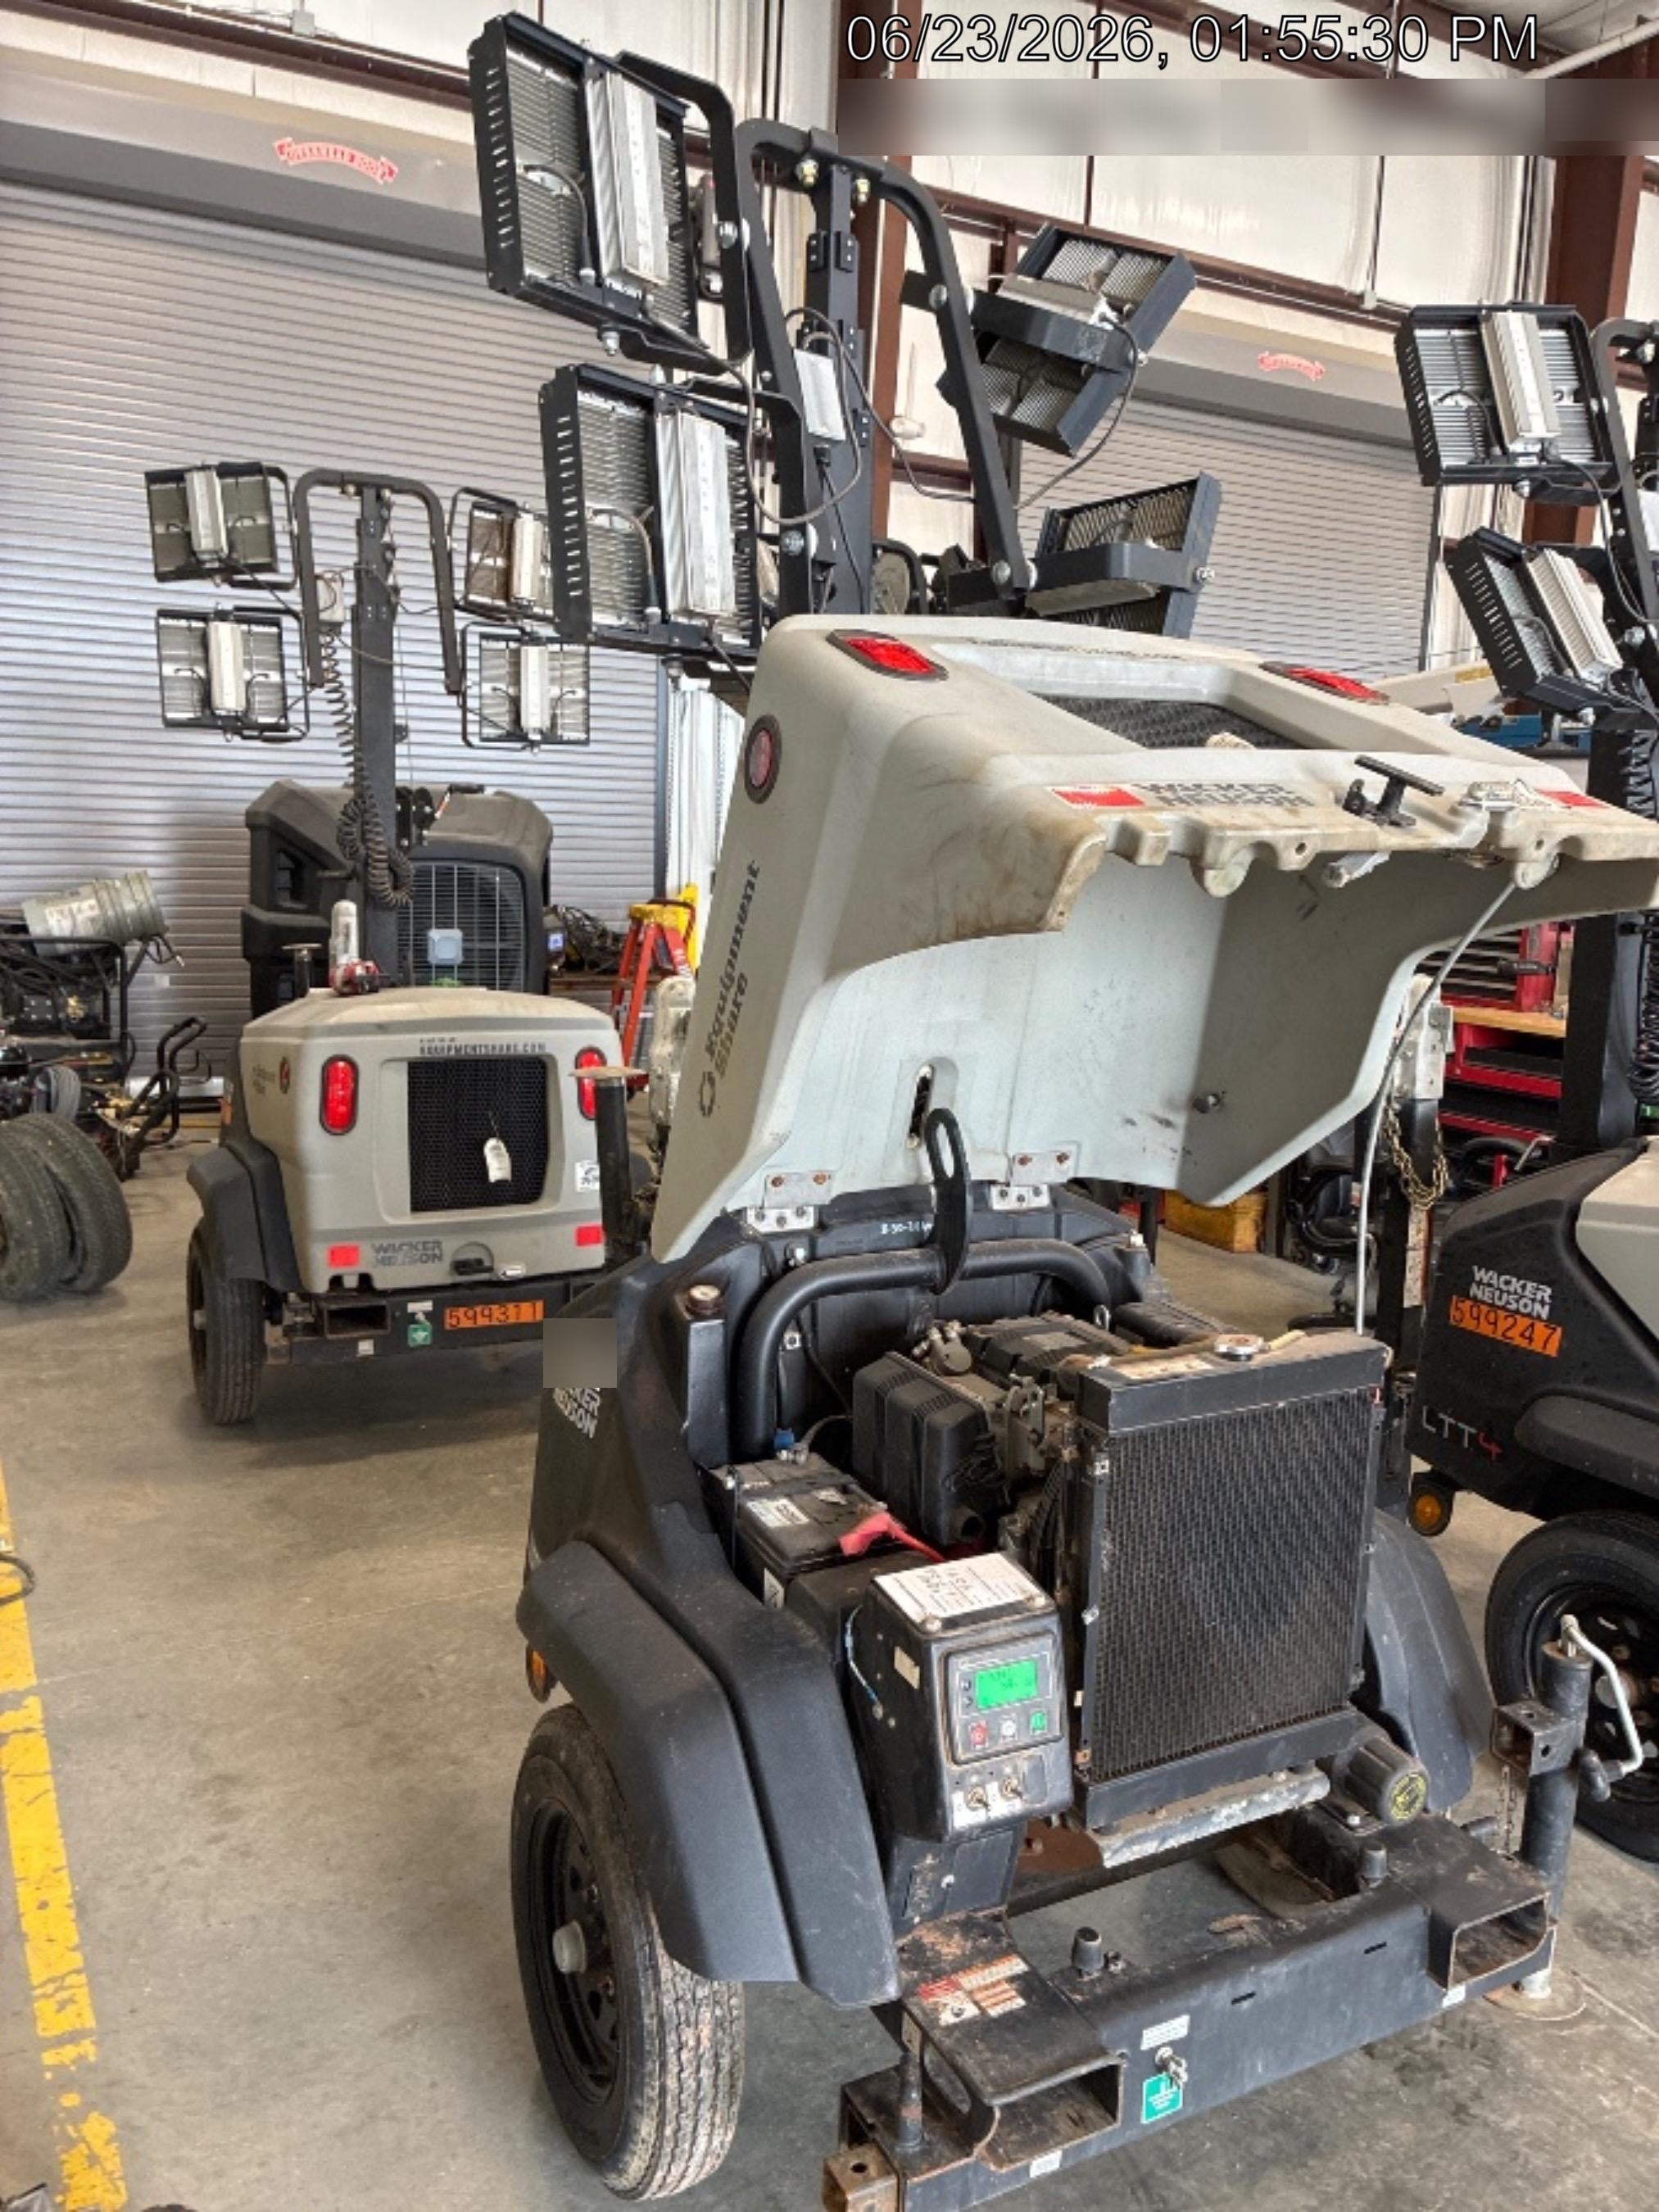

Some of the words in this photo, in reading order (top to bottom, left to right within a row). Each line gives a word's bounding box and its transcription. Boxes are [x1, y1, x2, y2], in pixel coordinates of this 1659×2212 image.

[1469, 1283, 1550, 1320] NEUSON
[1472, 1265, 1552, 1303] WACKER
[1451, 1299, 1558, 1351] 599247
